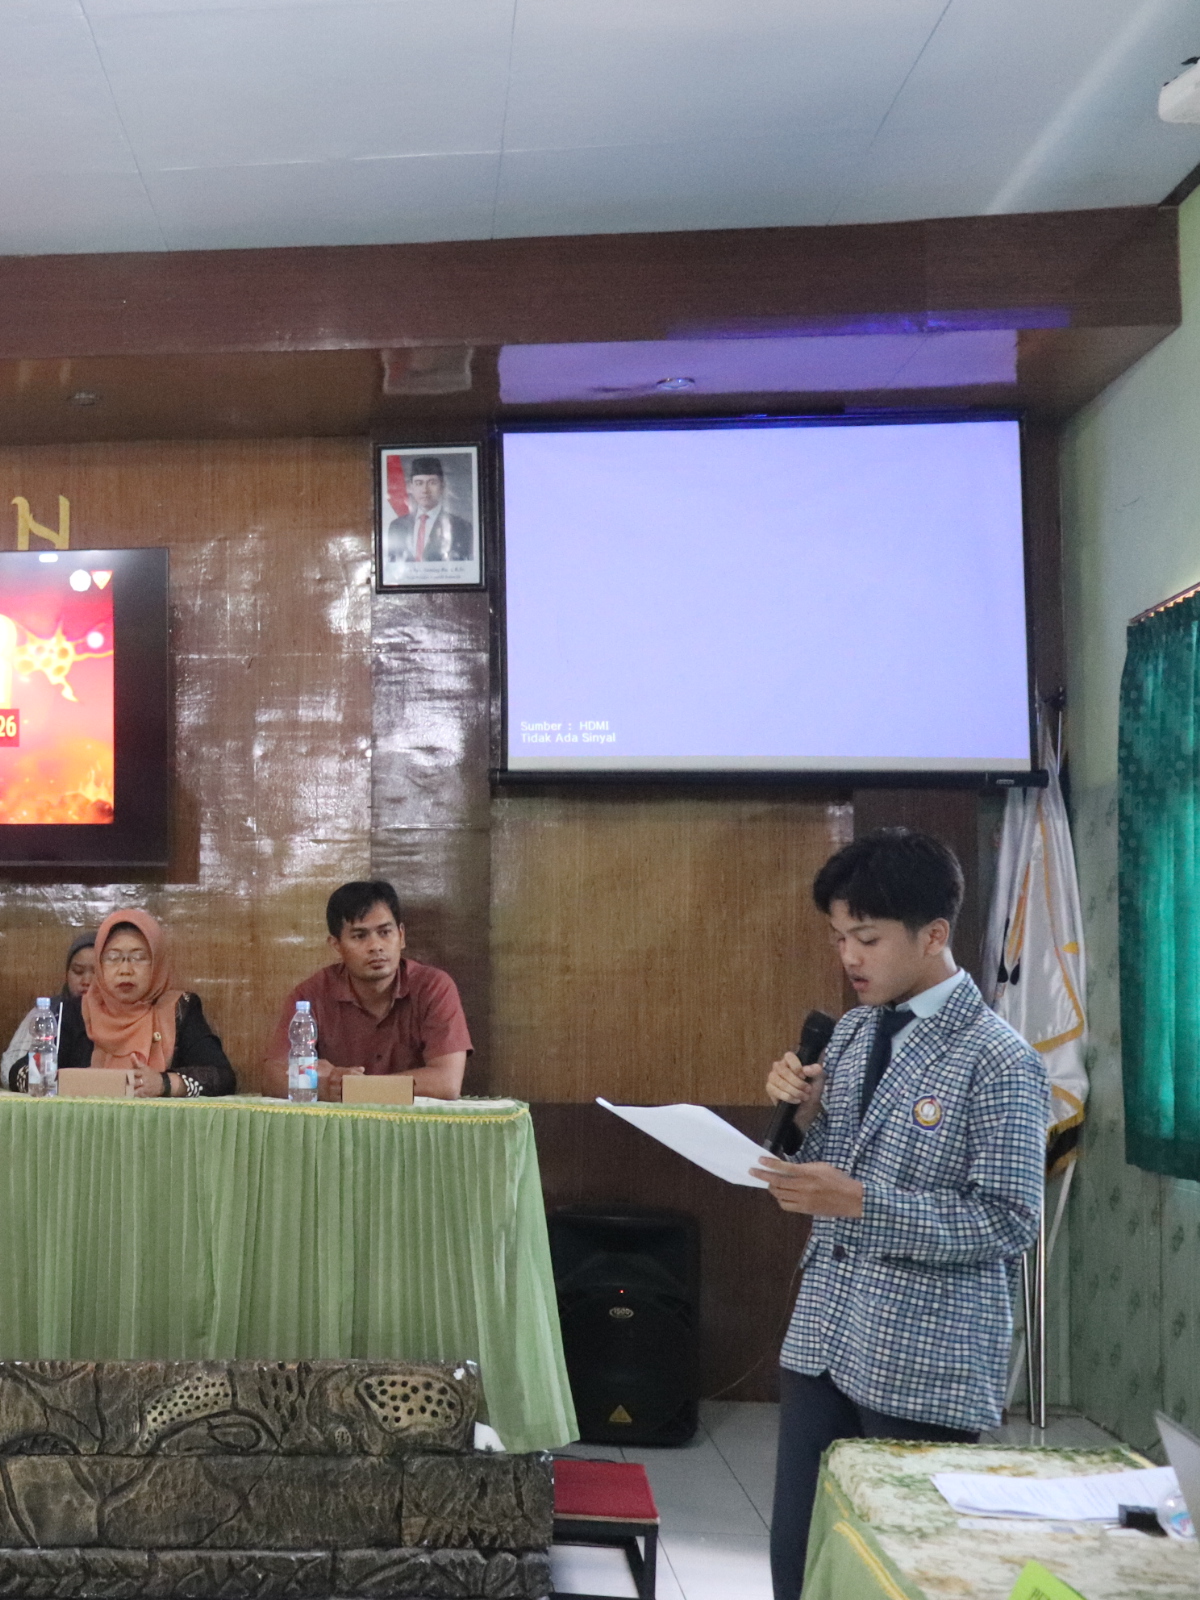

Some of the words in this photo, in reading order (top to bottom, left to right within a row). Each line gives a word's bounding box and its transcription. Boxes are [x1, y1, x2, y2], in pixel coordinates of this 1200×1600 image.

[520, 721, 562, 731] Sumber
[579, 721, 609, 731] HDMI
[521, 732, 551, 743] Tidak
[555, 733, 578, 743] Ada
[582, 732, 616, 744] Sinyal
